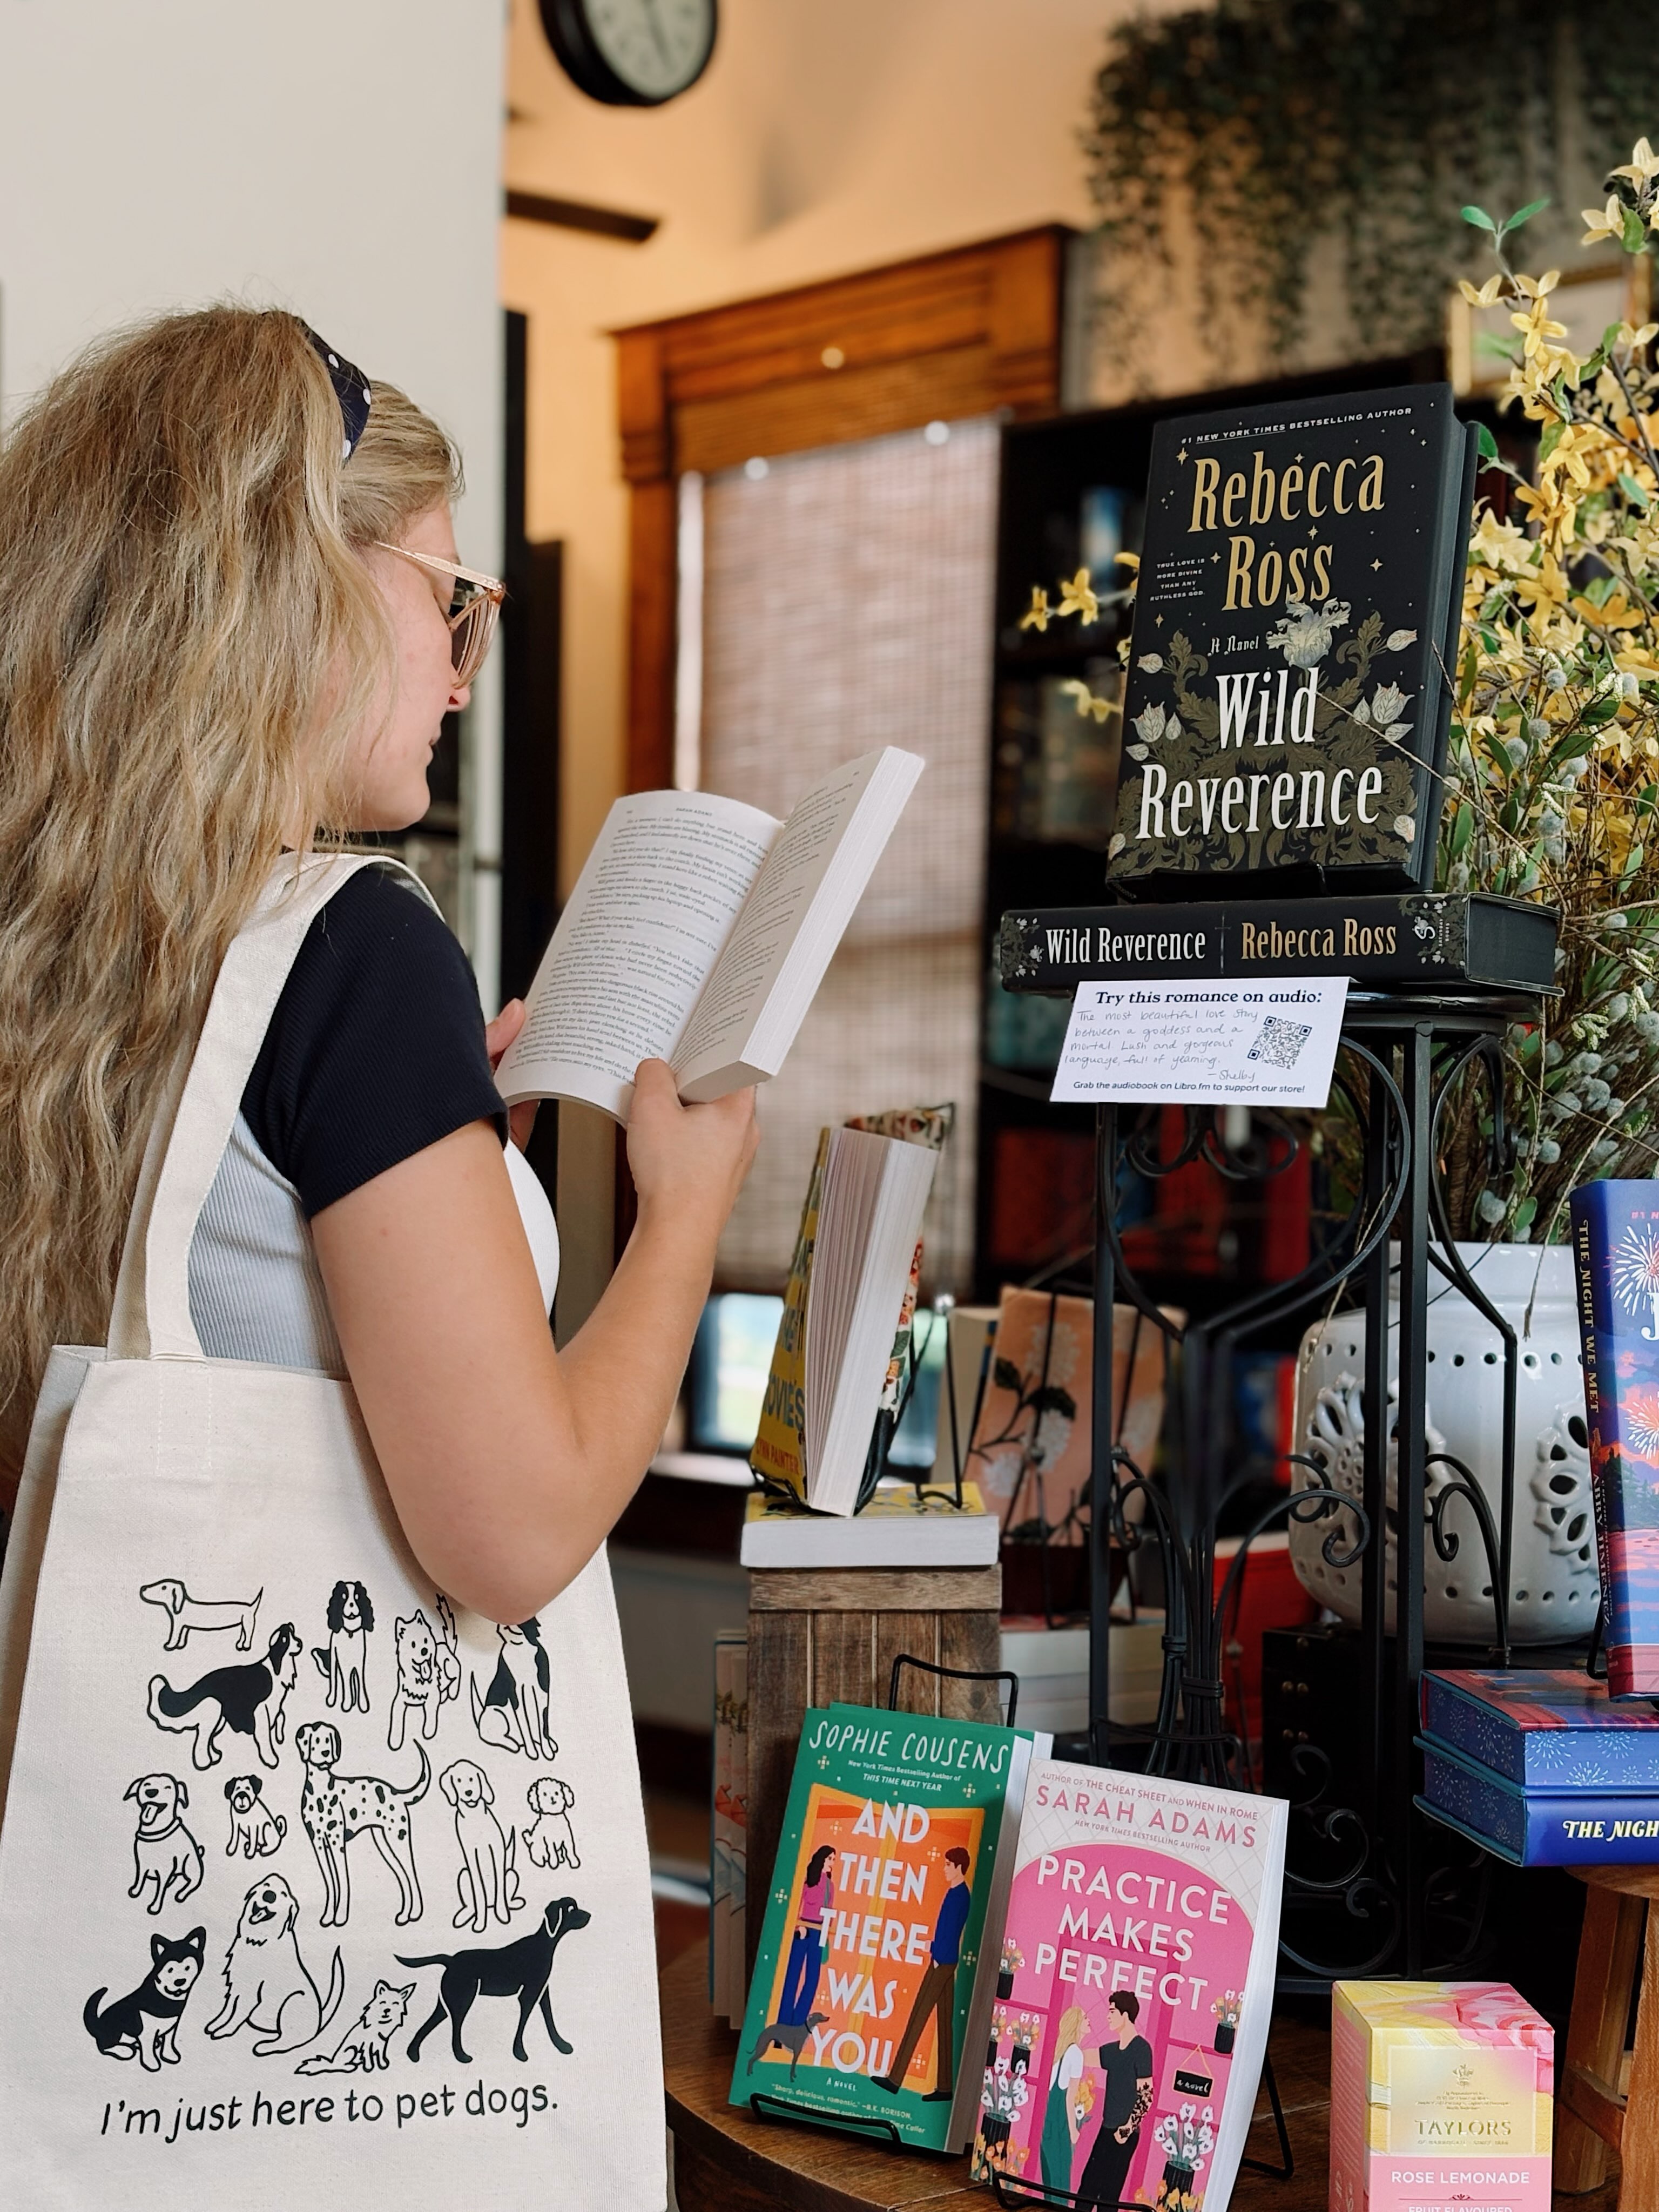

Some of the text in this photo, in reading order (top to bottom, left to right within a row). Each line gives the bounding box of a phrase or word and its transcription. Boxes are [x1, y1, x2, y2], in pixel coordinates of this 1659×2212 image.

[1196, 433, 1219, 442] NEW
[1223, 429, 1251, 439] YORK
[1253, 423, 1286, 434] TIMES
[1289, 413, 1363, 430] BESTSELLING
[1366, 407, 1412, 420] AUTHOR
[1188, 450, 1385, 533] Rebecca
[1222, 535, 1333, 611] Ross
[1150, 592, 1186, 602] RUTHLESS
[1224, 636, 1259, 656] Novel
[1215, 667, 1320, 749] Wild
[1135, 764, 1382, 840] Reverence
[1046, 918, 1396, 964] Wild Reverence Rebecca Ross
[1077, 1010, 1095, 1021] The
[1105, 1010, 1131, 1020] most
[1141, 1009, 1197, 1020] beautiful
[1206, 1009, 1226, 1019] love
[1095, 989, 1322, 1006] Try this romance on audio:
[1075, 1027, 1120, 1037] between
[1143, 1024, 1191, 1042] goddess
[1196, 1023, 1225, 1034] and
[1121, 1041, 1147, 1051] Lush
[1153, 1040, 1177, 1050] and
[1184, 1038, 1233, 1054] gorgeous
[1123, 1054, 1148, 1064] full
[1153, 1054, 1165, 1064] of
[1219, 1069, 1256, 1083] Shelby
[1224, 1084, 1259, 1092] support
[1579, 1219, 1599, 1414] THE NIGHT WE MET
[763, 1374, 805, 1433] OVIES
[1593, 1473, 1603, 1527] ABBY
[1597, 1532, 1612, 1628] JIMENEZ
[809, 1721, 1009, 1773] SOPHIE COUSENS
[863, 1762, 876, 1770] York
[878, 1764, 895, 1772] Times
[896, 1766, 930, 1778] Bestselling
[931, 1772, 953, 1781] Author
[863, 1773, 942, 1791] THIS TIME NEXT YEAR
[1036, 1785, 1256, 1848] SARAH ADAMS
[1041, 1773, 1071, 1784] AUTHOR
[1086, 1779, 1103, 1790] THE
[1105, 1784, 1136, 1796] CHEAT
[1138, 1789, 1166, 1802] SHEET
[1168, 1797, 1184, 1806] AND
[1186, 1798, 1215, 1812] WHEN
[1217, 1804, 1228, 1815] IN
[1229, 1808, 1258, 1820] ROME
[852, 1798, 930, 1844] AND
[1075, 1819, 1211, 1852] NEW YORK TIMES BESTSELLING AUTHOR
[1562, 1820, 1659, 1842] THE NIGH
[839, 1852, 929, 1905] THEN
[1037, 1855, 1231, 1925] PRACTICE
[818, 1907, 929, 1965] THERE
[1058, 1904, 1194, 1962] MAKES
[827, 1967, 899, 2019] WAS
[1035, 1943, 1209, 2011] PERFECT
[810, 2026, 894, 2078] YOU
[826, 2078, 857, 2092] A NOVEL
[1185, 2081, 1209, 2093] novel
[100, 2079, 559, 2144] I'm just here to pet dogs.
[1414, 2119, 1512, 2136] TAYLORS
[1391, 2171, 1530, 2184] ROSE LEMONADE
